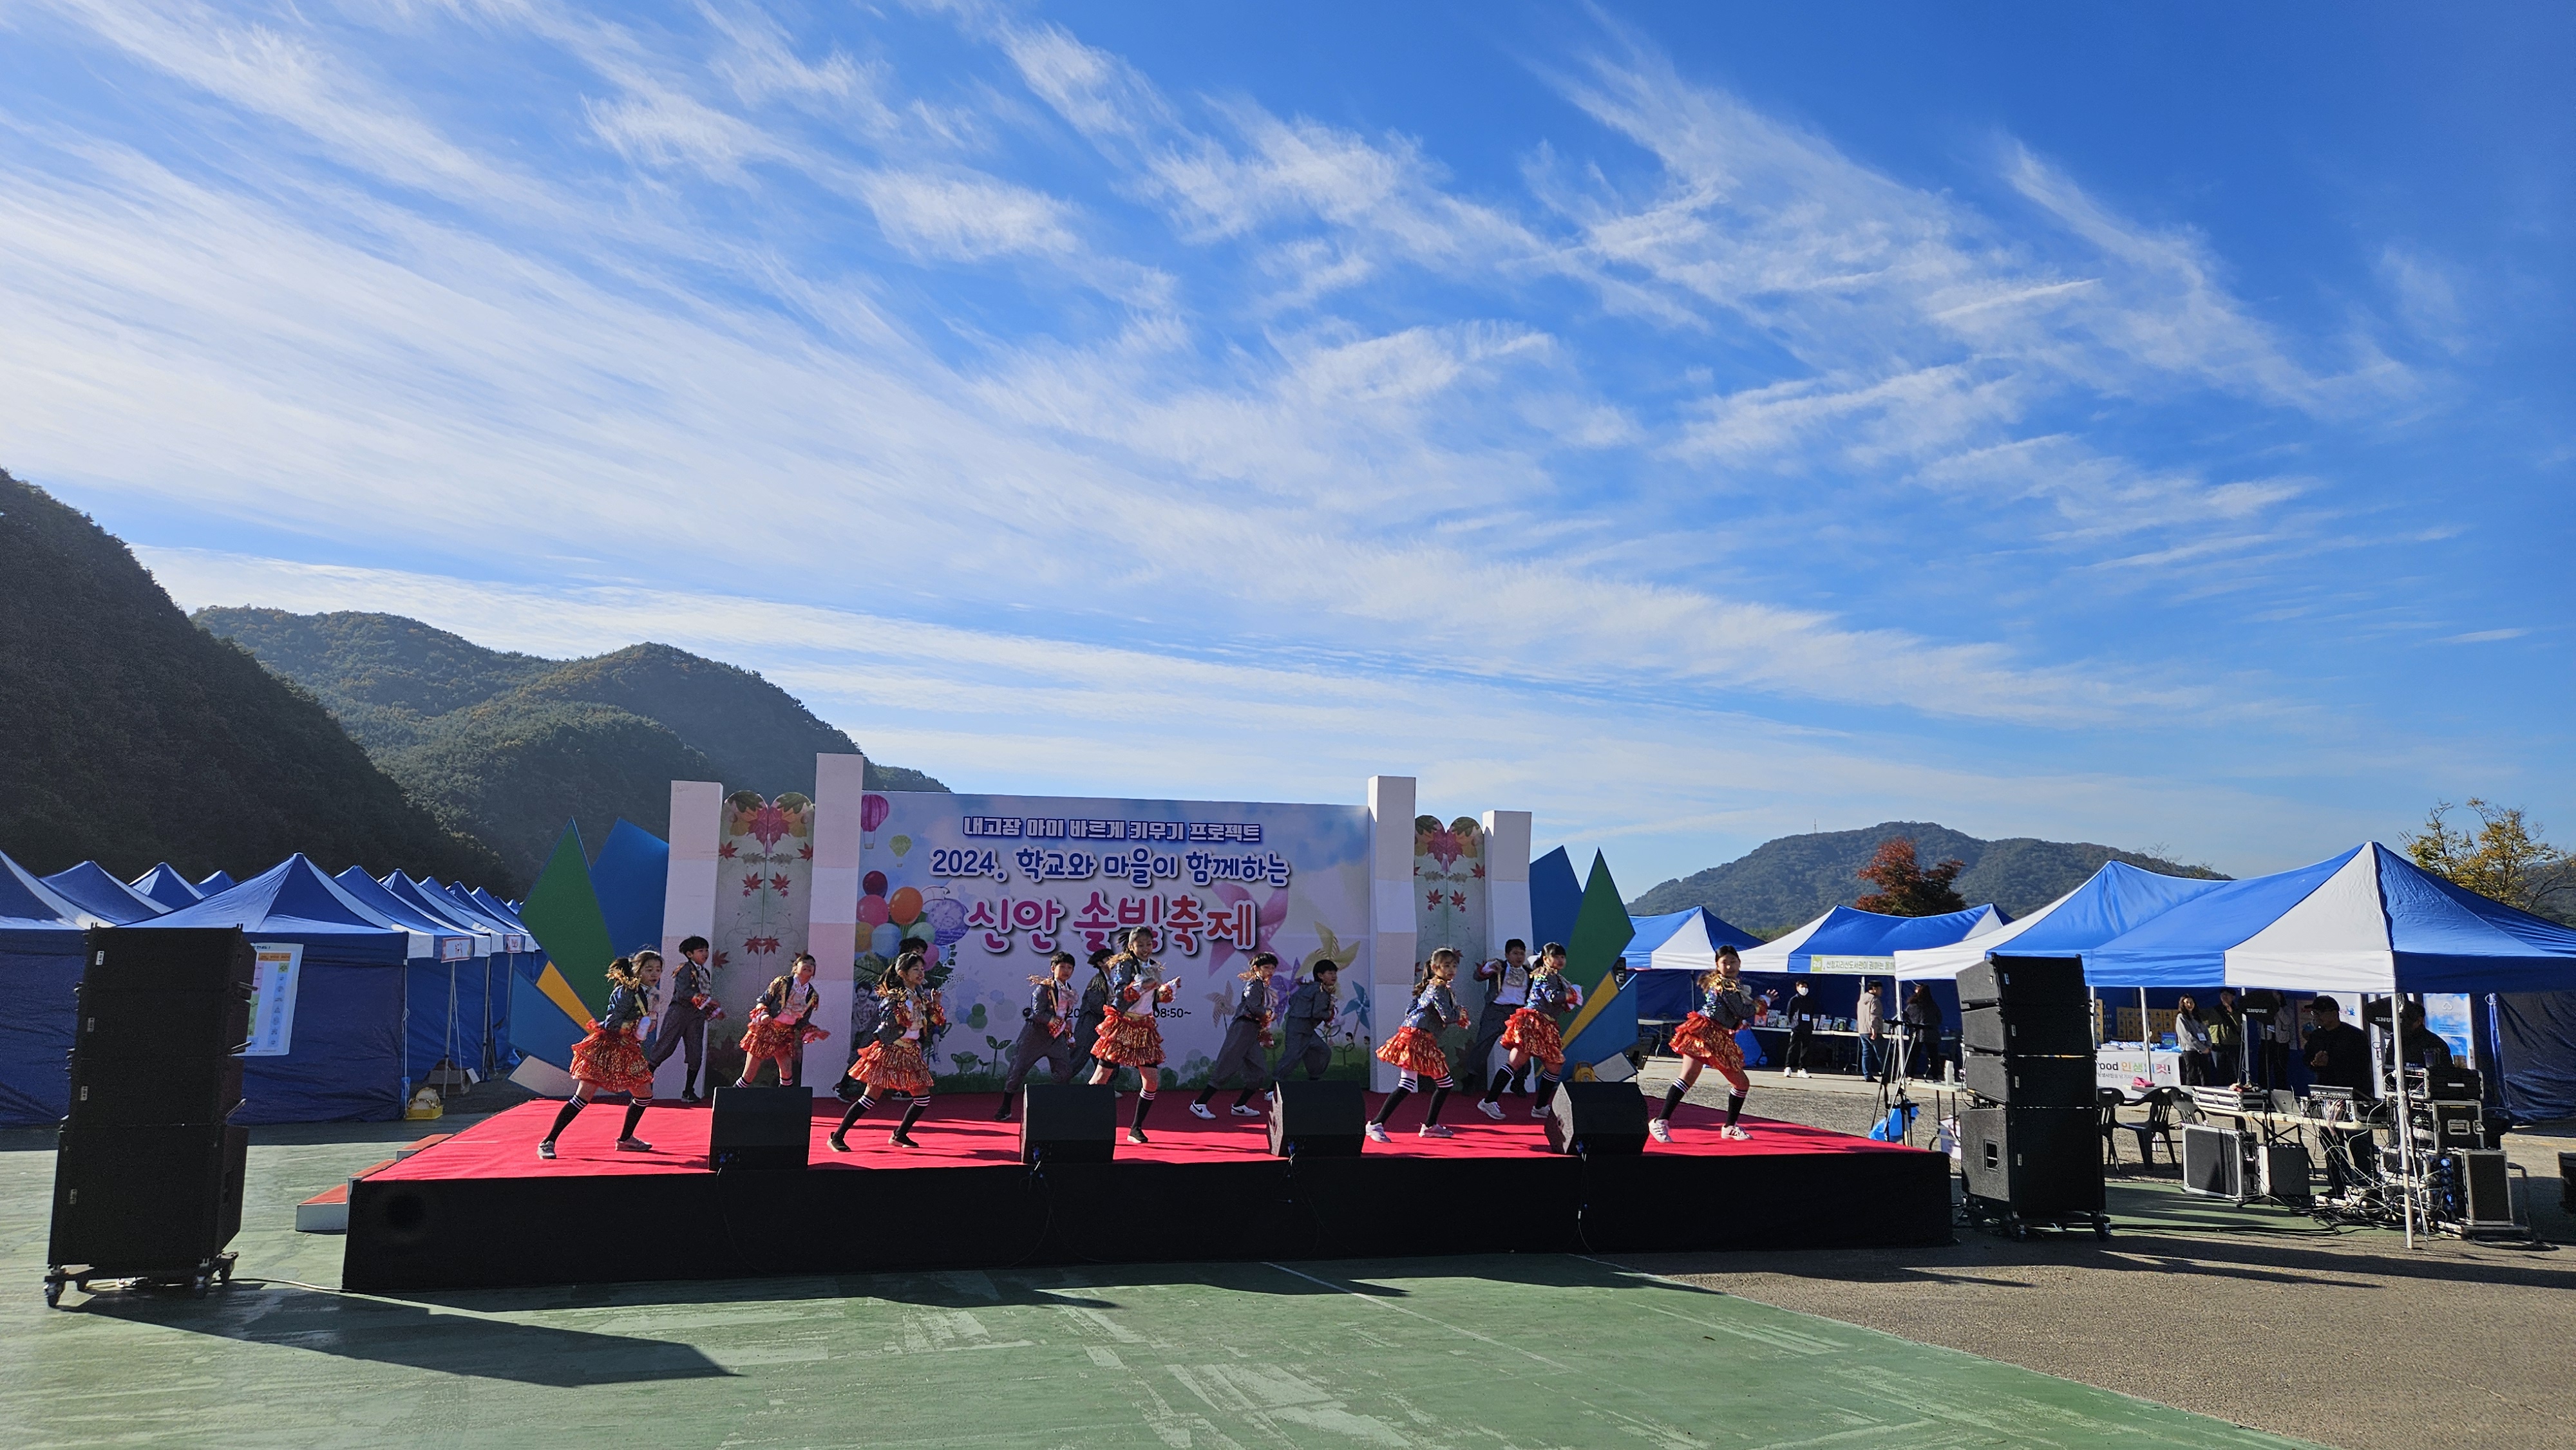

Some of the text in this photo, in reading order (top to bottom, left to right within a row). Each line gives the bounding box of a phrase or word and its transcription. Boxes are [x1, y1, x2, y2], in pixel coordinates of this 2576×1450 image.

[963, 816, 1260, 842] 내고장 아이 바르게 키우기 프로젝트
[1016, 848, 1094, 880] 학교와
[1104, 848, 1175, 884] 마을이
[1186, 849, 1287, 884] 함께하는
[967, 898, 1061, 950] 신안
[2099, 1062, 2119, 1071] ood
